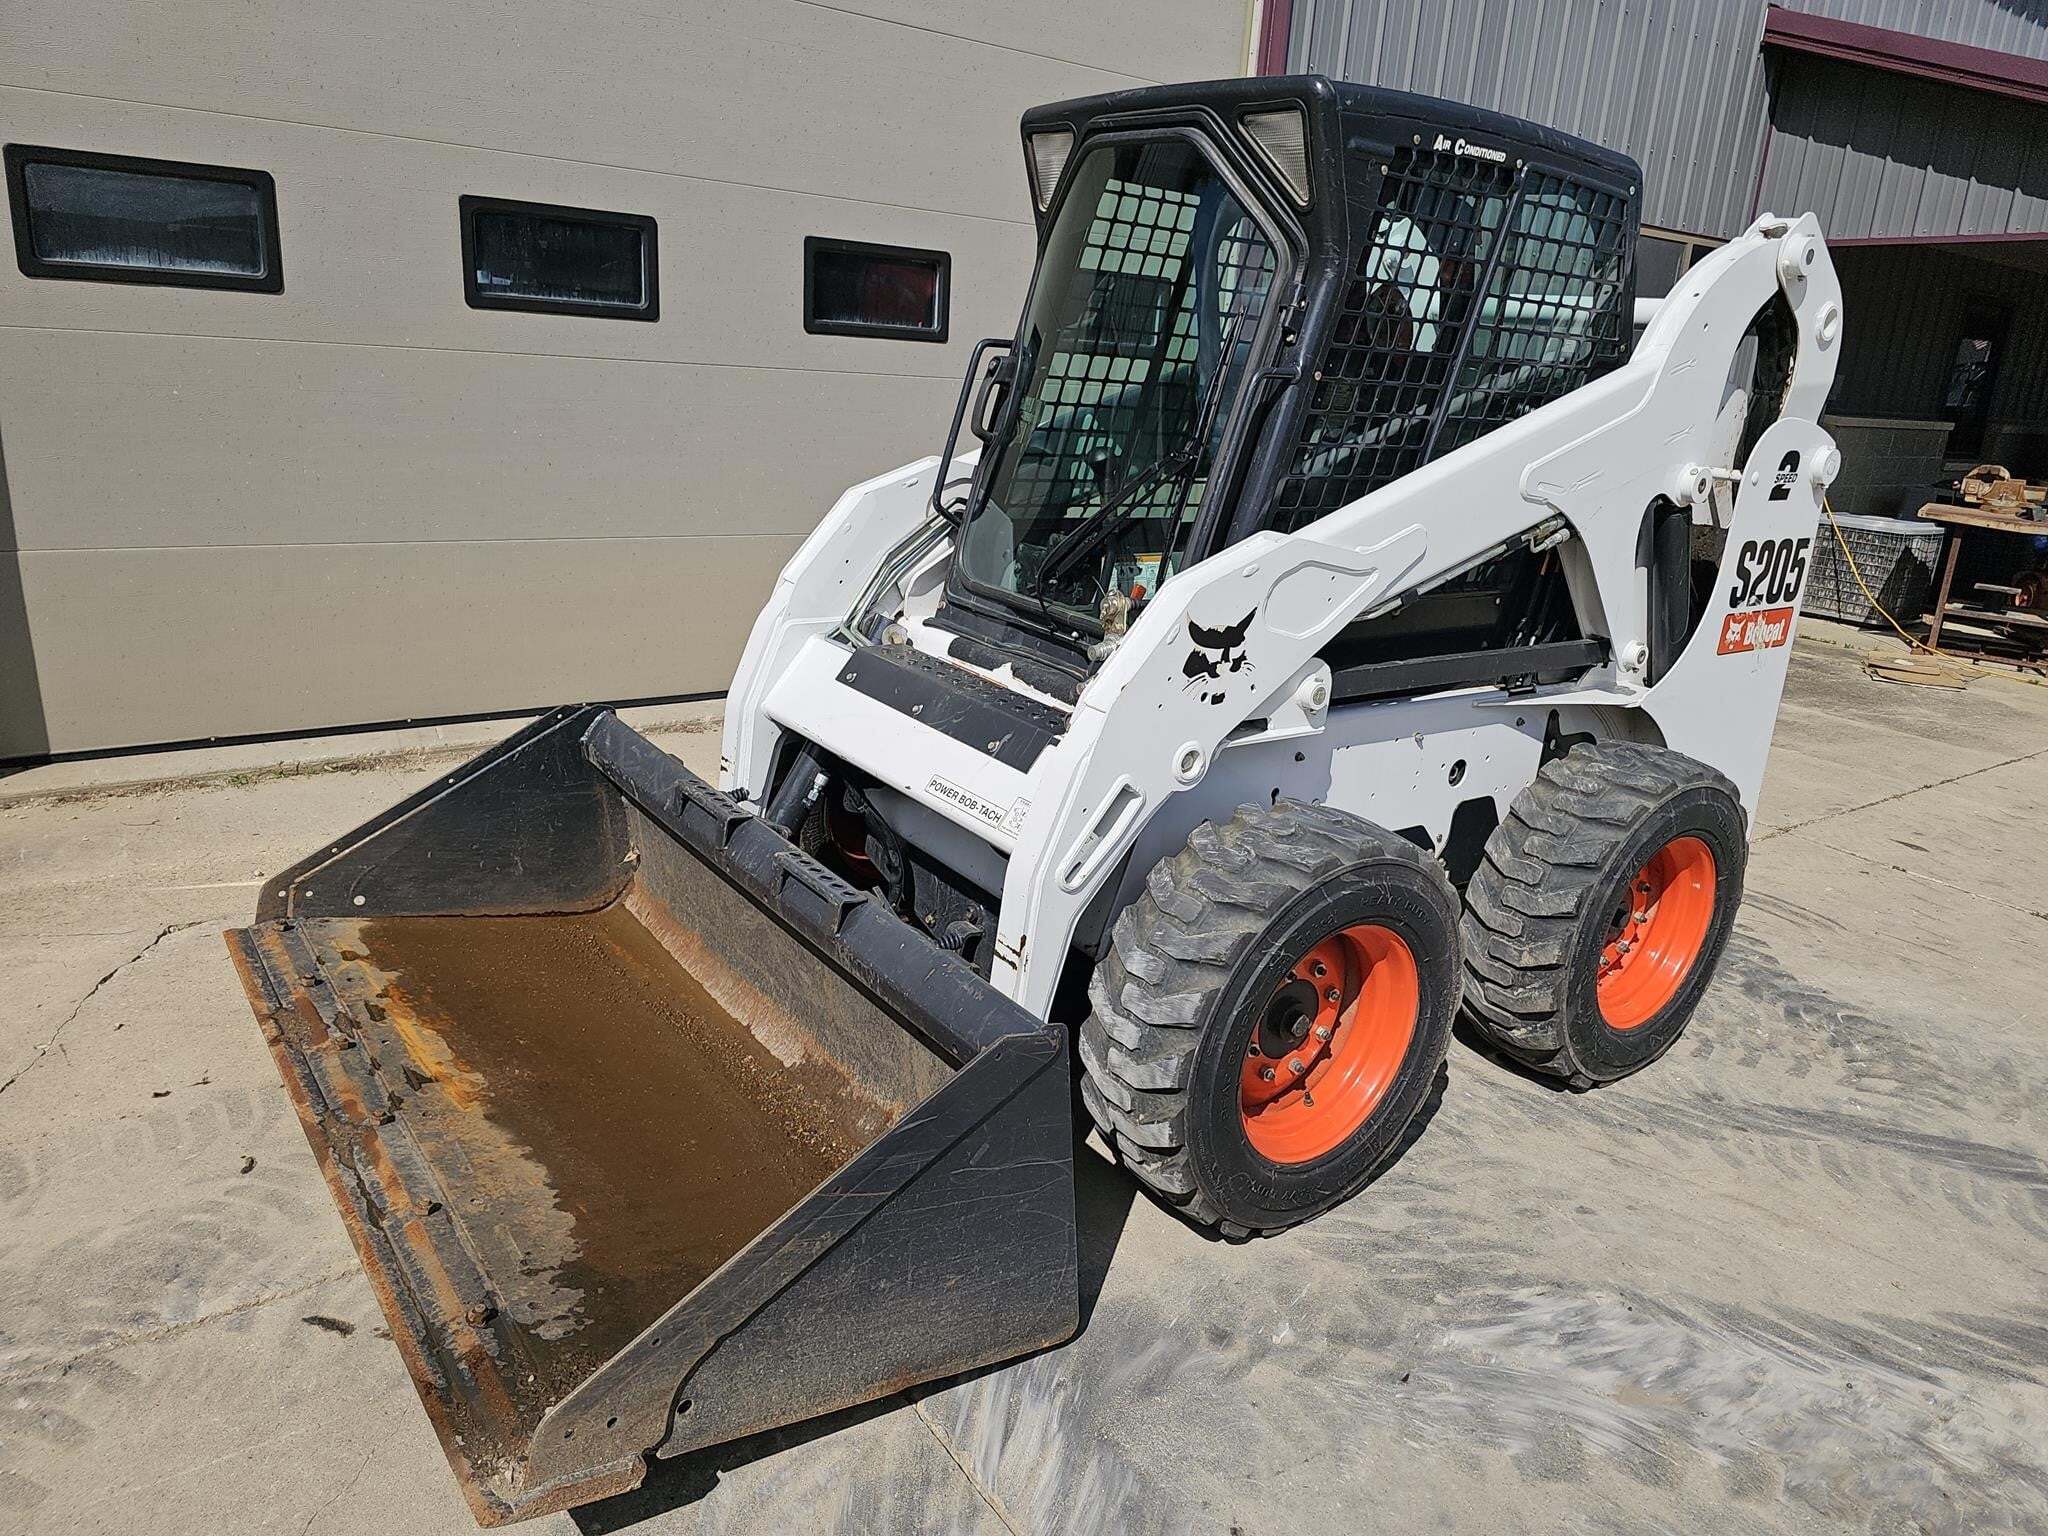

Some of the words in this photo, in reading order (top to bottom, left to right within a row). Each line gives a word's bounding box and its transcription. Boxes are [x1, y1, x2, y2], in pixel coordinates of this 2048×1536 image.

[1768, 450, 1801, 501] 2
[1774, 473, 1798, 484] SPEED
[1729, 537, 1811, 609] S205
[929, 779, 960, 800] POWER
[958, 794, 1003, 823] BOB-TACH
